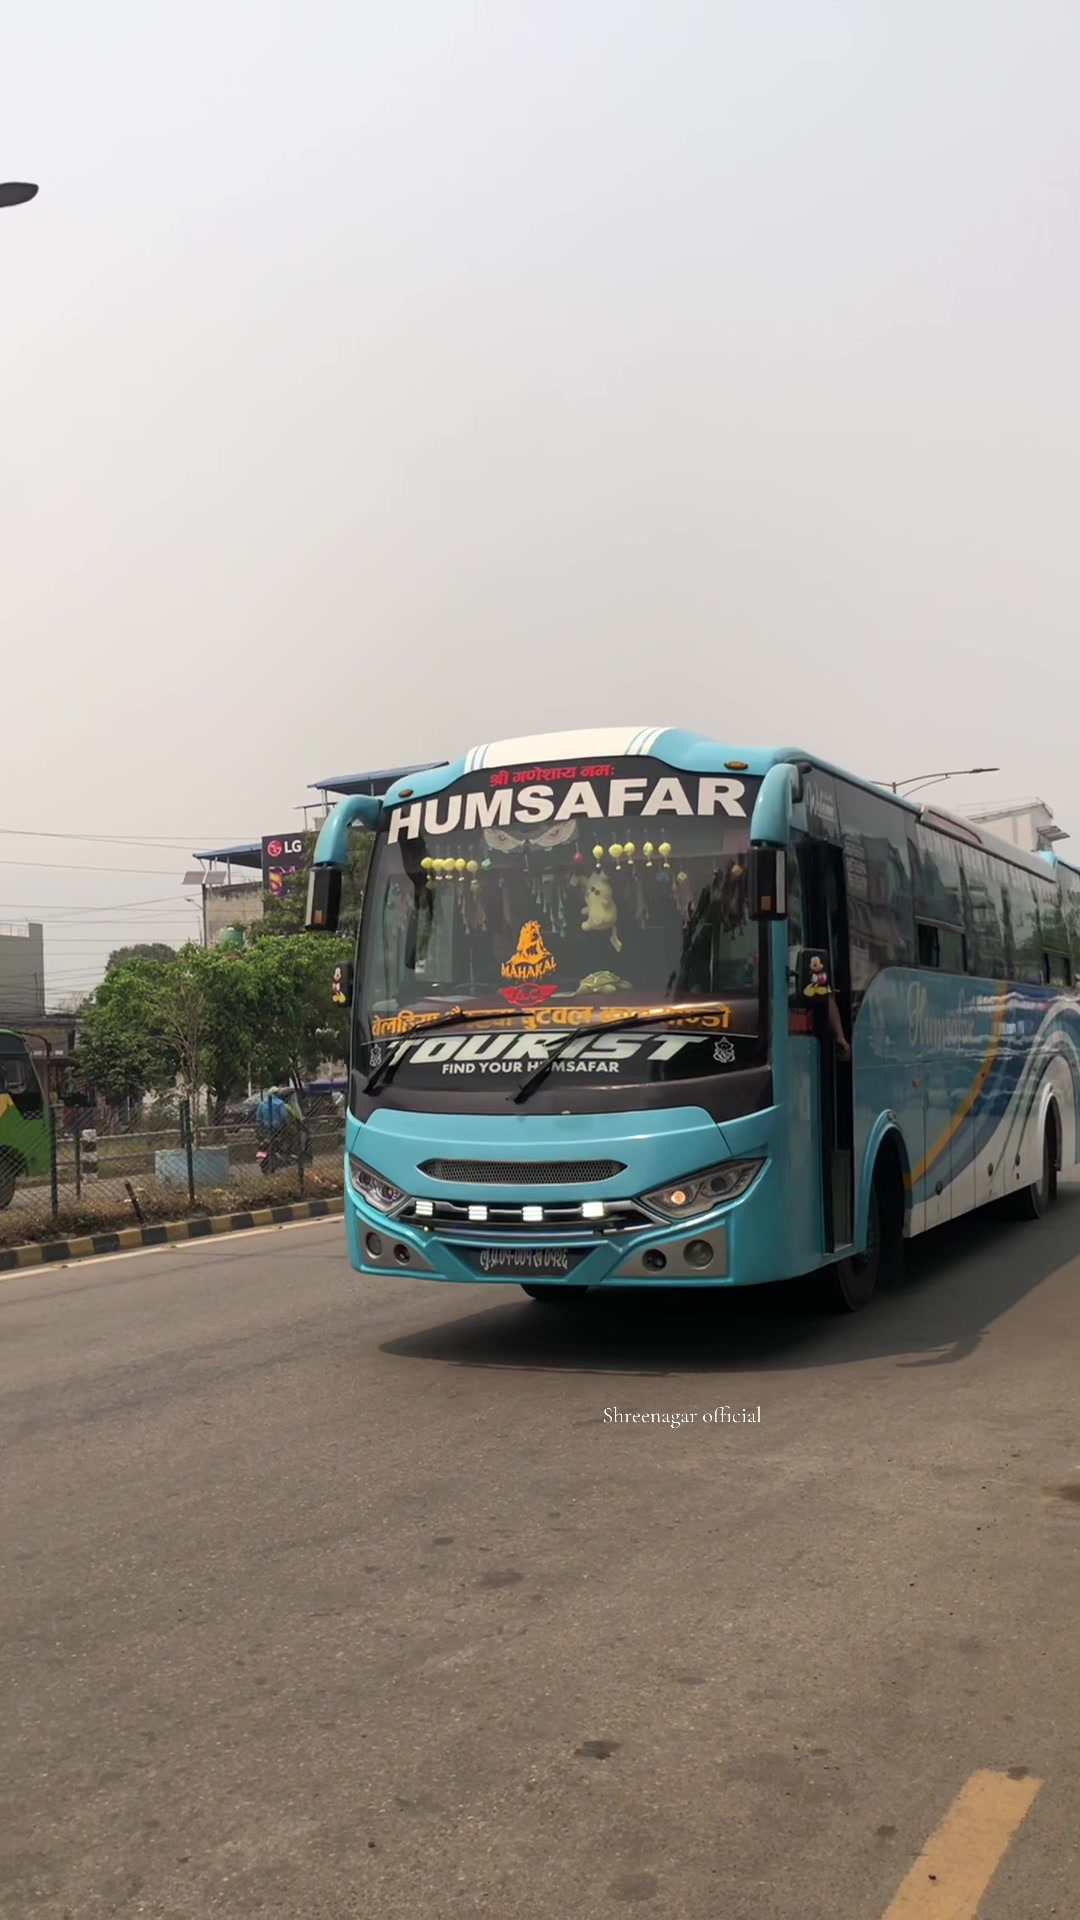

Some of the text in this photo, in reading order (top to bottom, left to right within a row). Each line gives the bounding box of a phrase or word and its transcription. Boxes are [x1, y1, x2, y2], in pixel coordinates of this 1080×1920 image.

[490, 769, 509, 787] श्री
[513, 766, 577, 781] गणेशाय
[387, 778, 747, 845] HUMSAFAR
[284, 839, 302, 853] LG
[501, 956, 557, 980] MAHAKAL
[520, 1006, 593, 1031] बुटवल
[386, 1033, 710, 1067] TOURIST
[442, 1061, 619, 1074] FIND YOUR HMSAFAR
